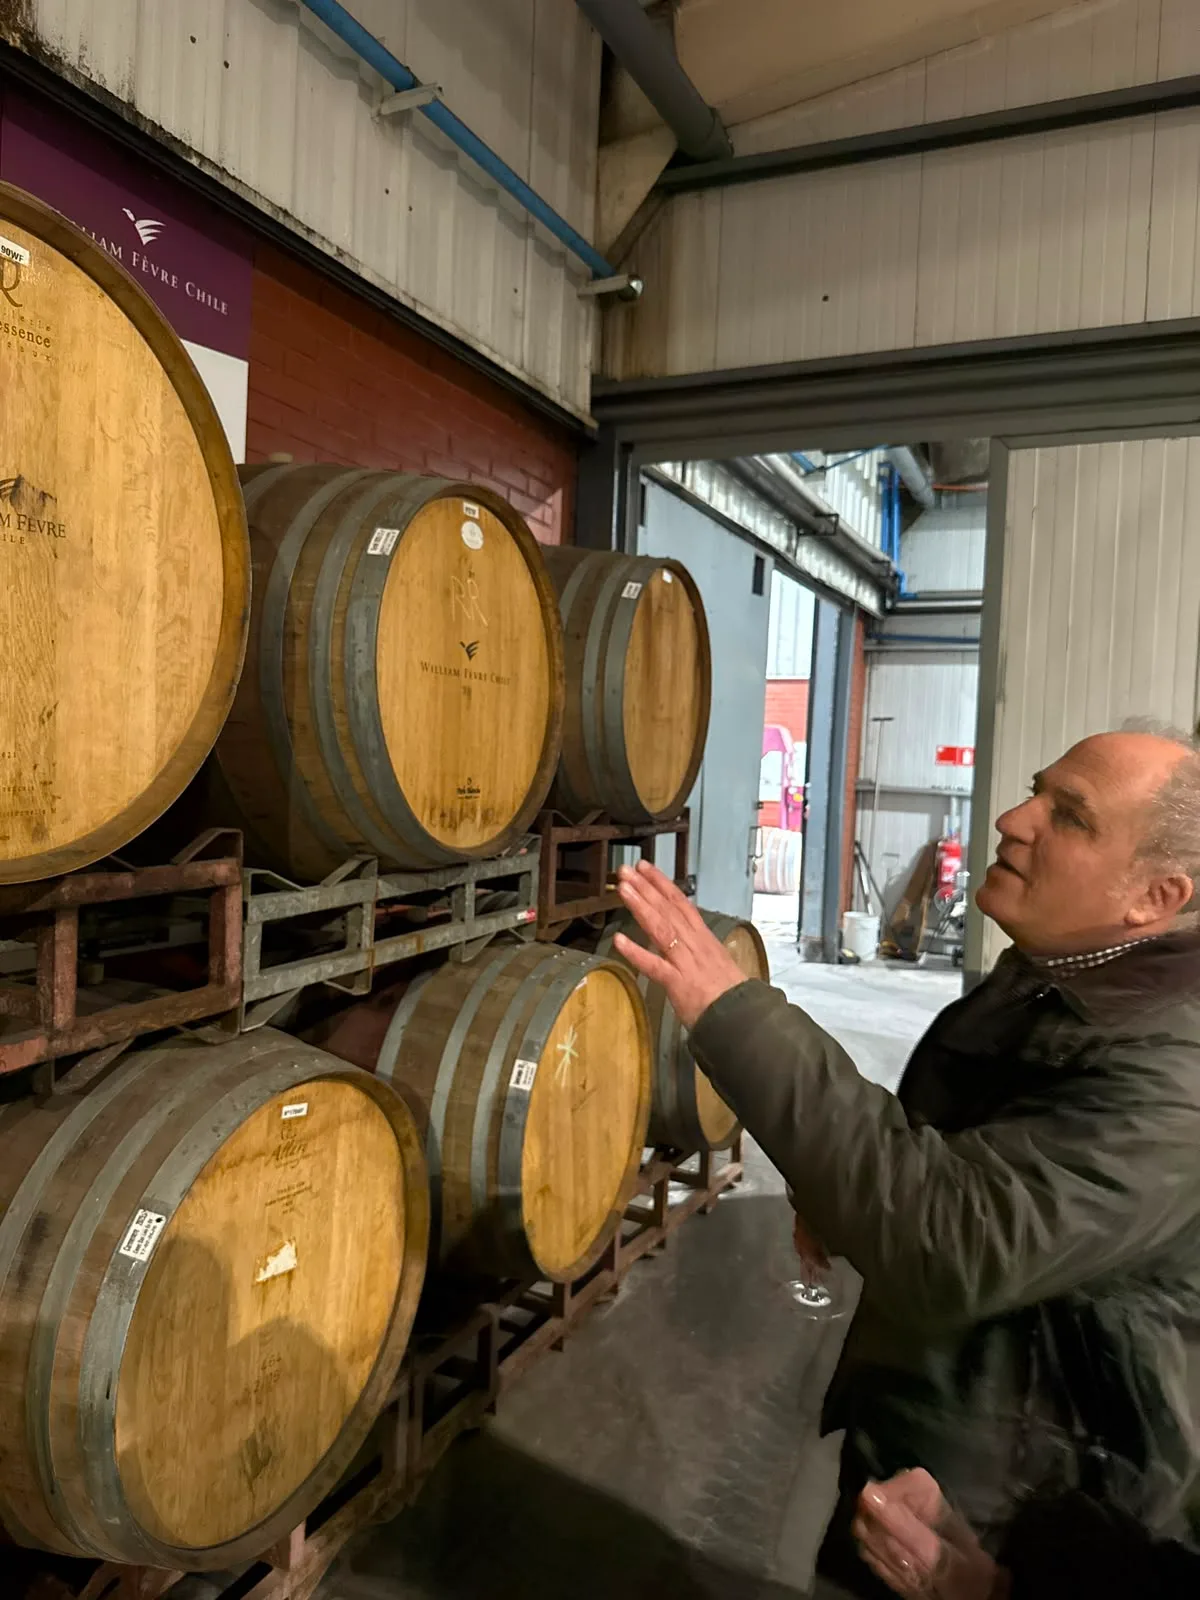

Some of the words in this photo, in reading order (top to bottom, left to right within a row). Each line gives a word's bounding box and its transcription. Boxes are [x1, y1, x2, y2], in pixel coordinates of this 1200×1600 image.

[132, 251, 179, 289] FÈVRE
[185, 281, 229, 316] CHILE
[420, 660, 461, 680] WILLIAM
